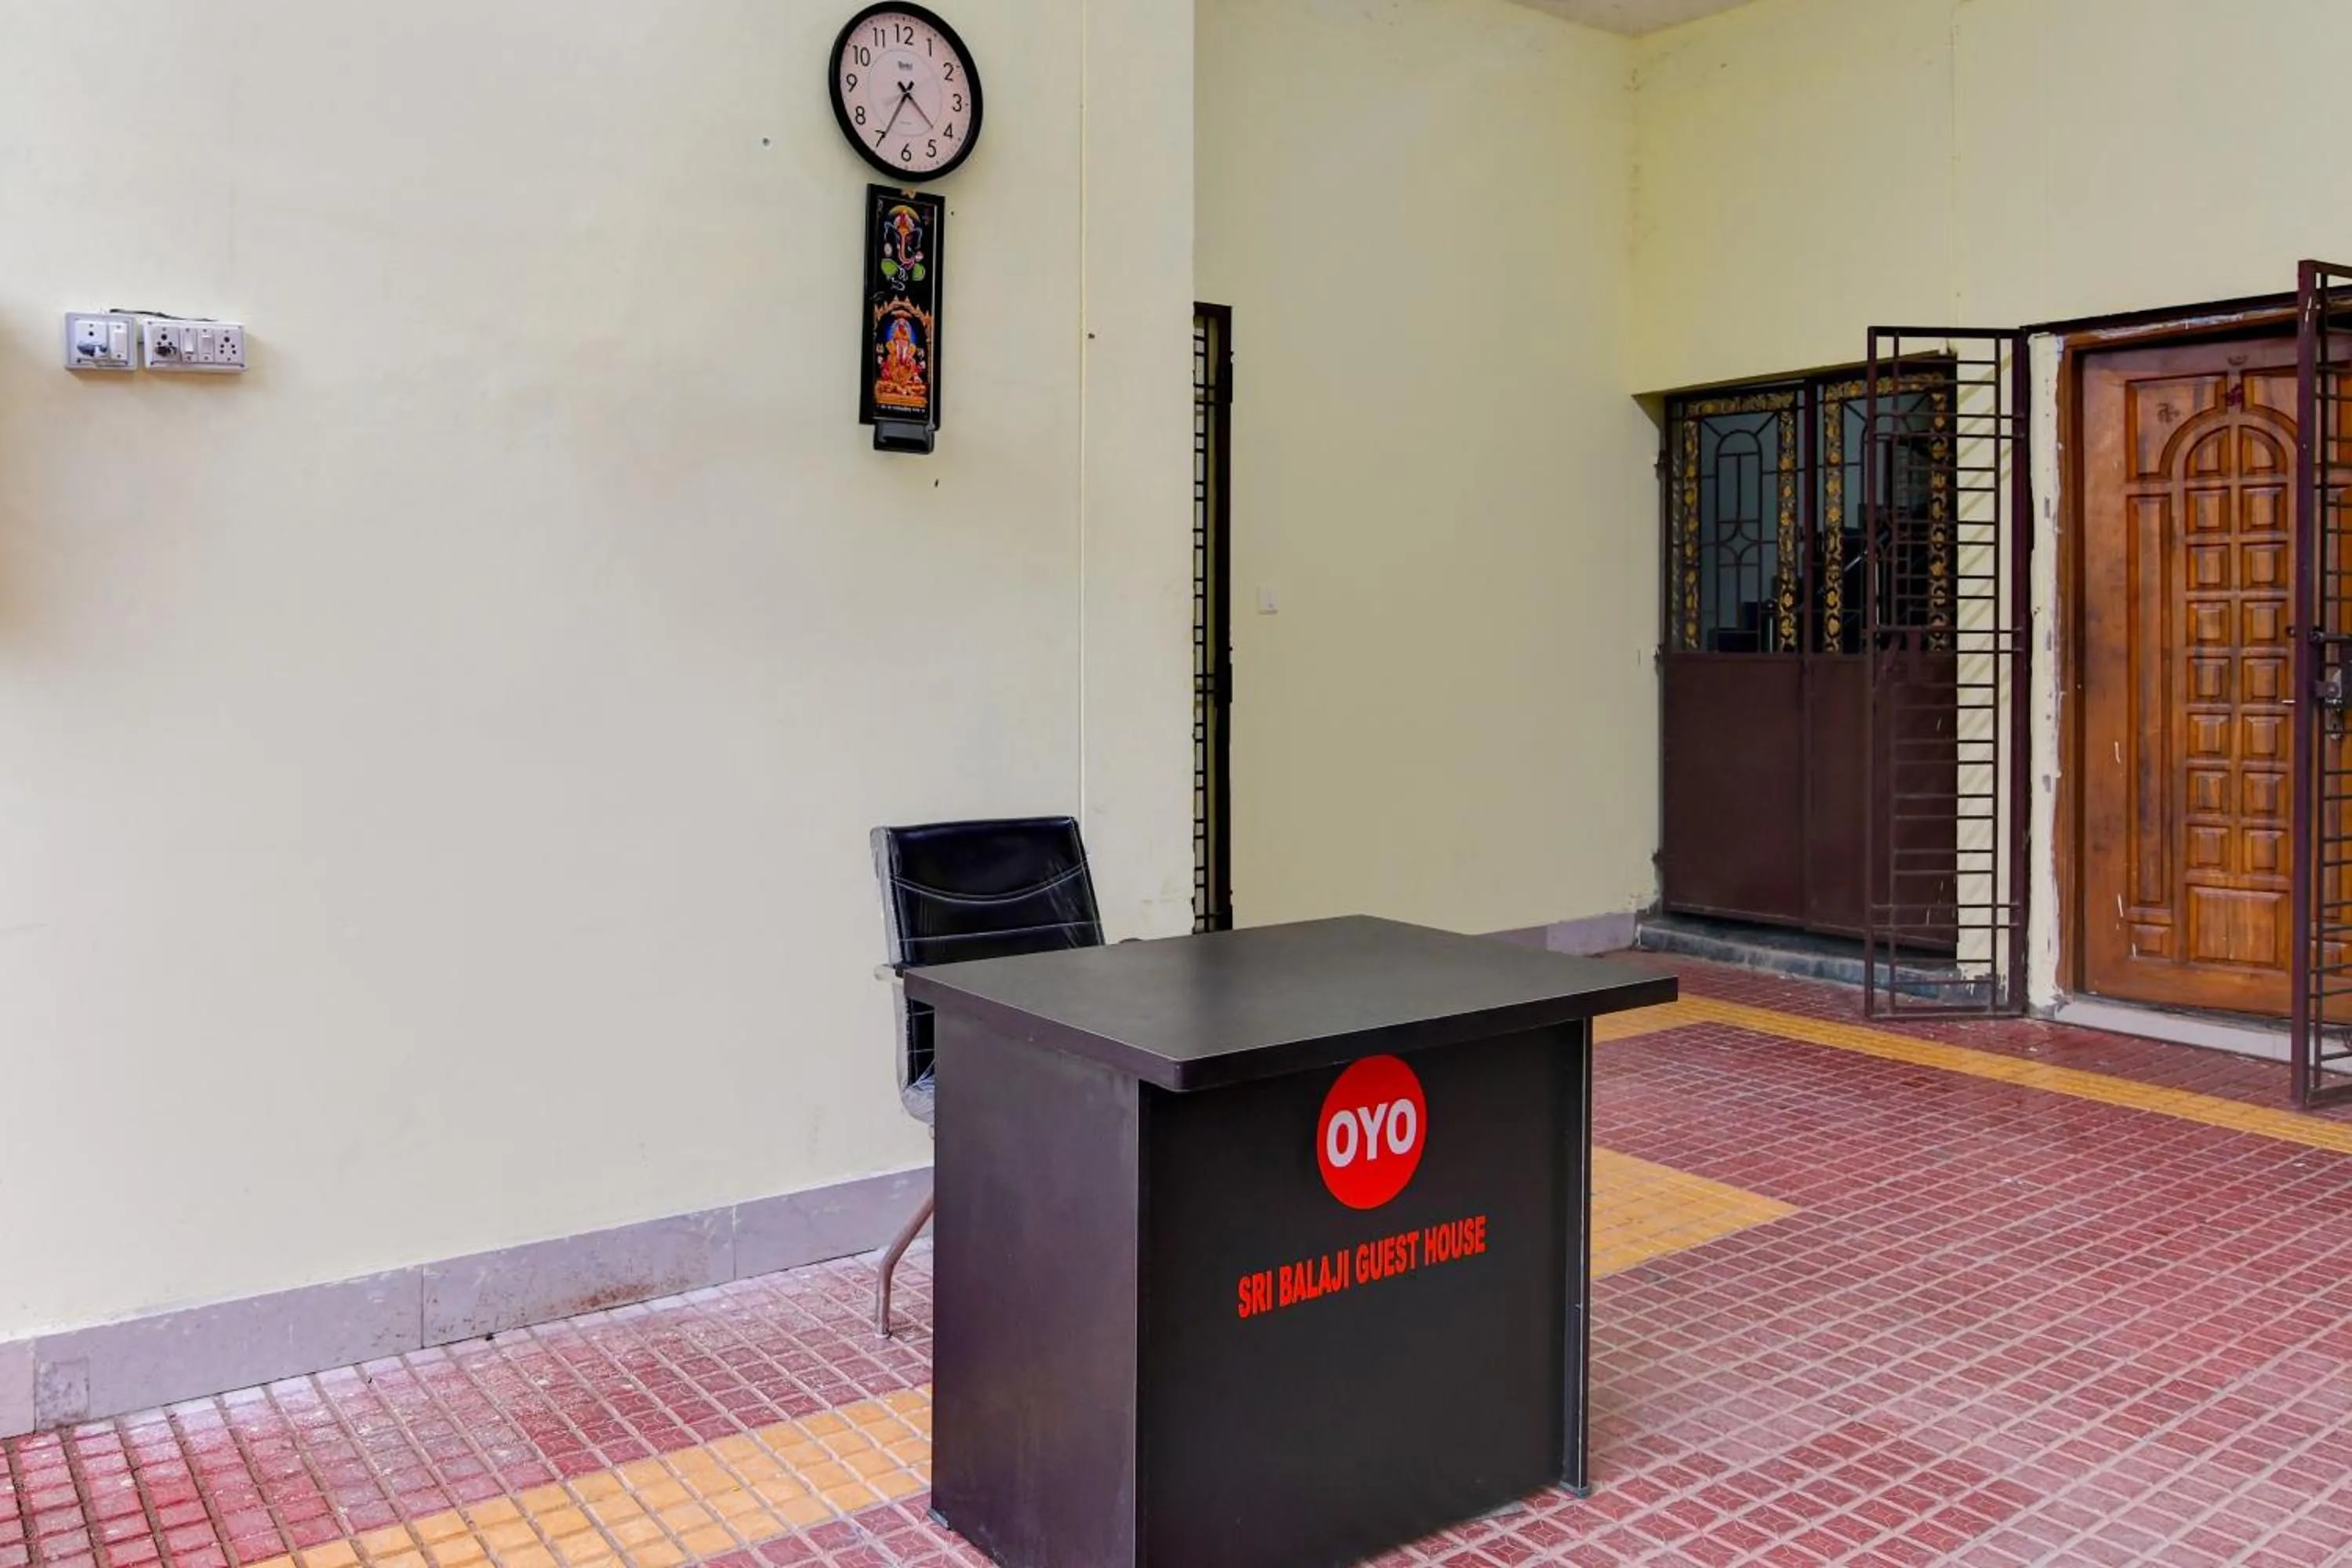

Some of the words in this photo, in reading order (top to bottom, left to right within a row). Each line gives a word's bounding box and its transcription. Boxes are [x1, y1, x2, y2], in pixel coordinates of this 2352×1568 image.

[873, 27, 885, 48] 11
[895, 24, 914, 45] 12
[853, 45, 871, 67] 10
[926, 38, 932, 57] 1
[943, 62, 954, 82] 2
[846, 73, 858, 93] 9
[953, 93, 963, 112] 3
[855, 106, 866, 125] 8
[874, 129, 886, 147] 7
[943, 122, 954, 139] 4
[902, 143, 912, 162] 6
[926, 139, 937, 158] 5
[1326, 1098, 1417, 1167] OYO
[1238, 1270, 1273, 1319] SRI
[1279, 1249, 1350, 1308] BALAJI
[1356, 1230, 1419, 1284] GUEST
[1425, 1215, 1486, 1266] HOUSE
